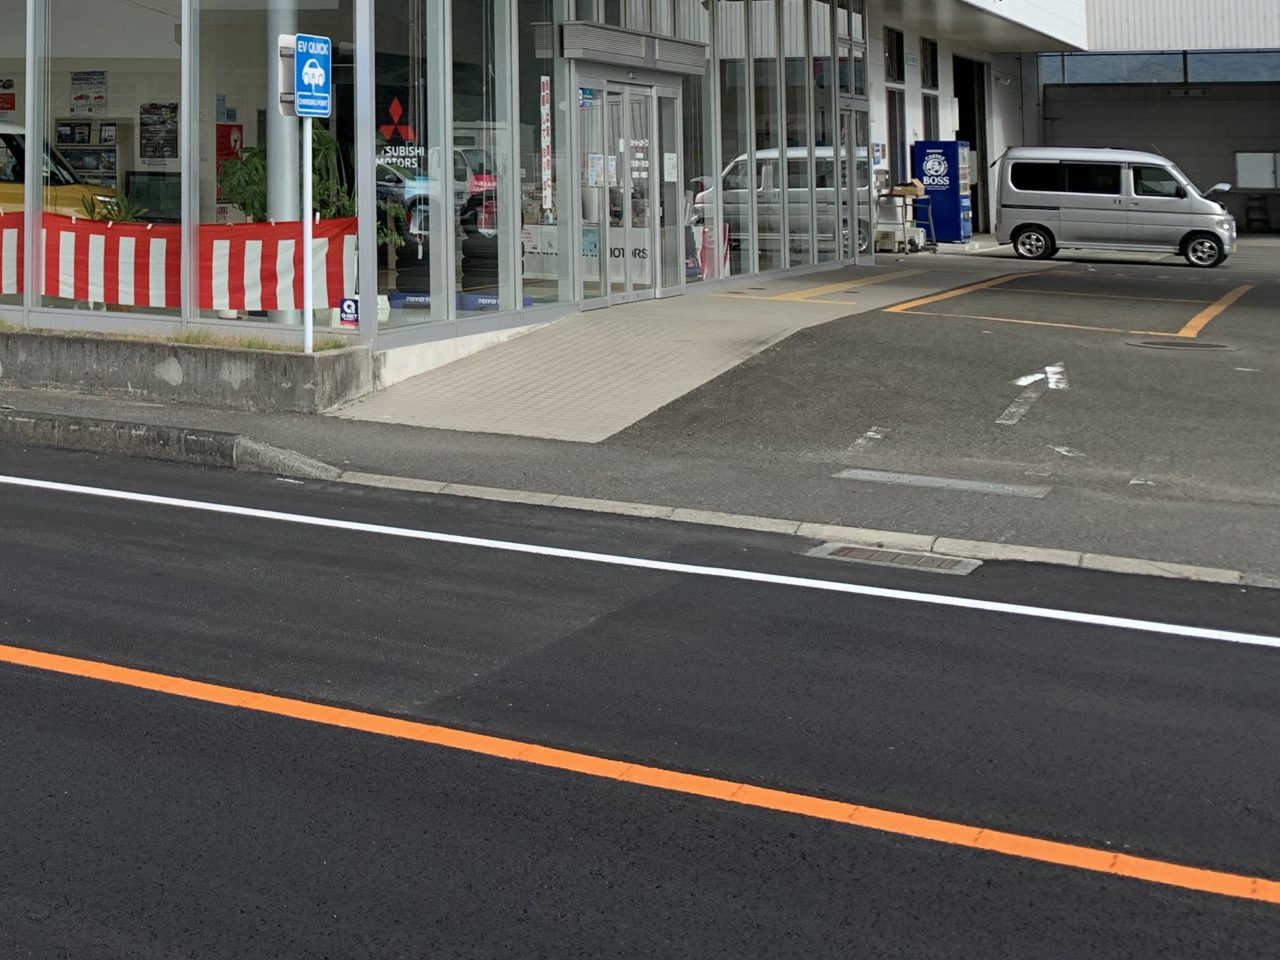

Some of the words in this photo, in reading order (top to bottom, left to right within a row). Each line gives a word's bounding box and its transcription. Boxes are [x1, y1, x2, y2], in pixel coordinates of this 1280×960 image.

[297, 40, 307, 53] EV
[308, 42, 328, 55] QUICK
[923, 176, 949, 185] BOSS
